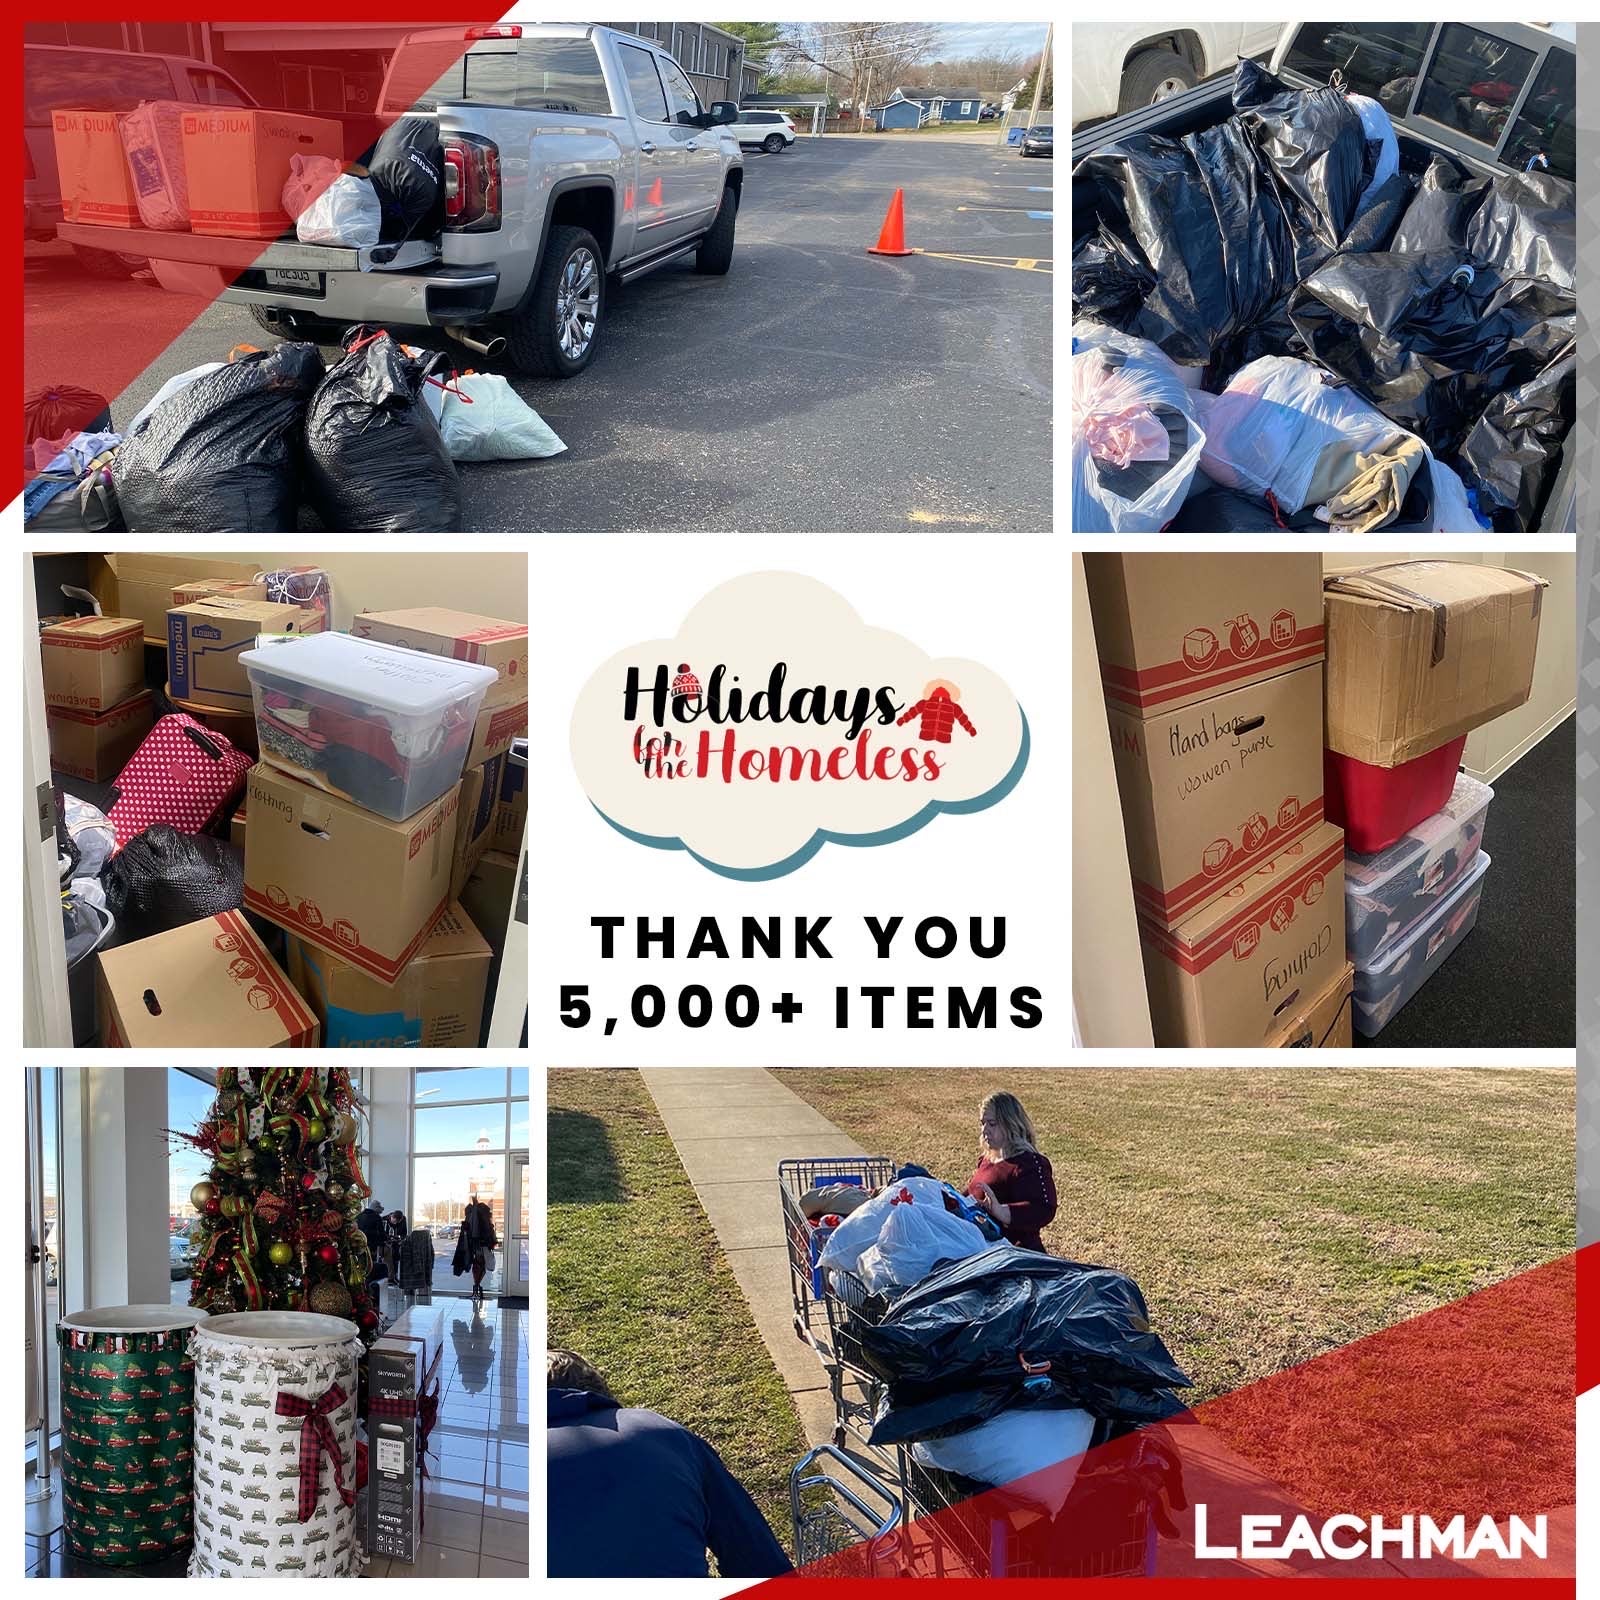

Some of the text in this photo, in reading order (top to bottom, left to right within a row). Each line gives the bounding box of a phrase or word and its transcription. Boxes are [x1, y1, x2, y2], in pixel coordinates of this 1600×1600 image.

[198, 119, 250, 134] MEDIUM
[174, 620, 188, 677] medium
[48, 693, 90, 707] MEDIUM
[1169, 719, 1209, 757] Hand
[421, 795, 460, 845] MEDIUM
[377, 1370, 406, 1379] SKYWORTH
